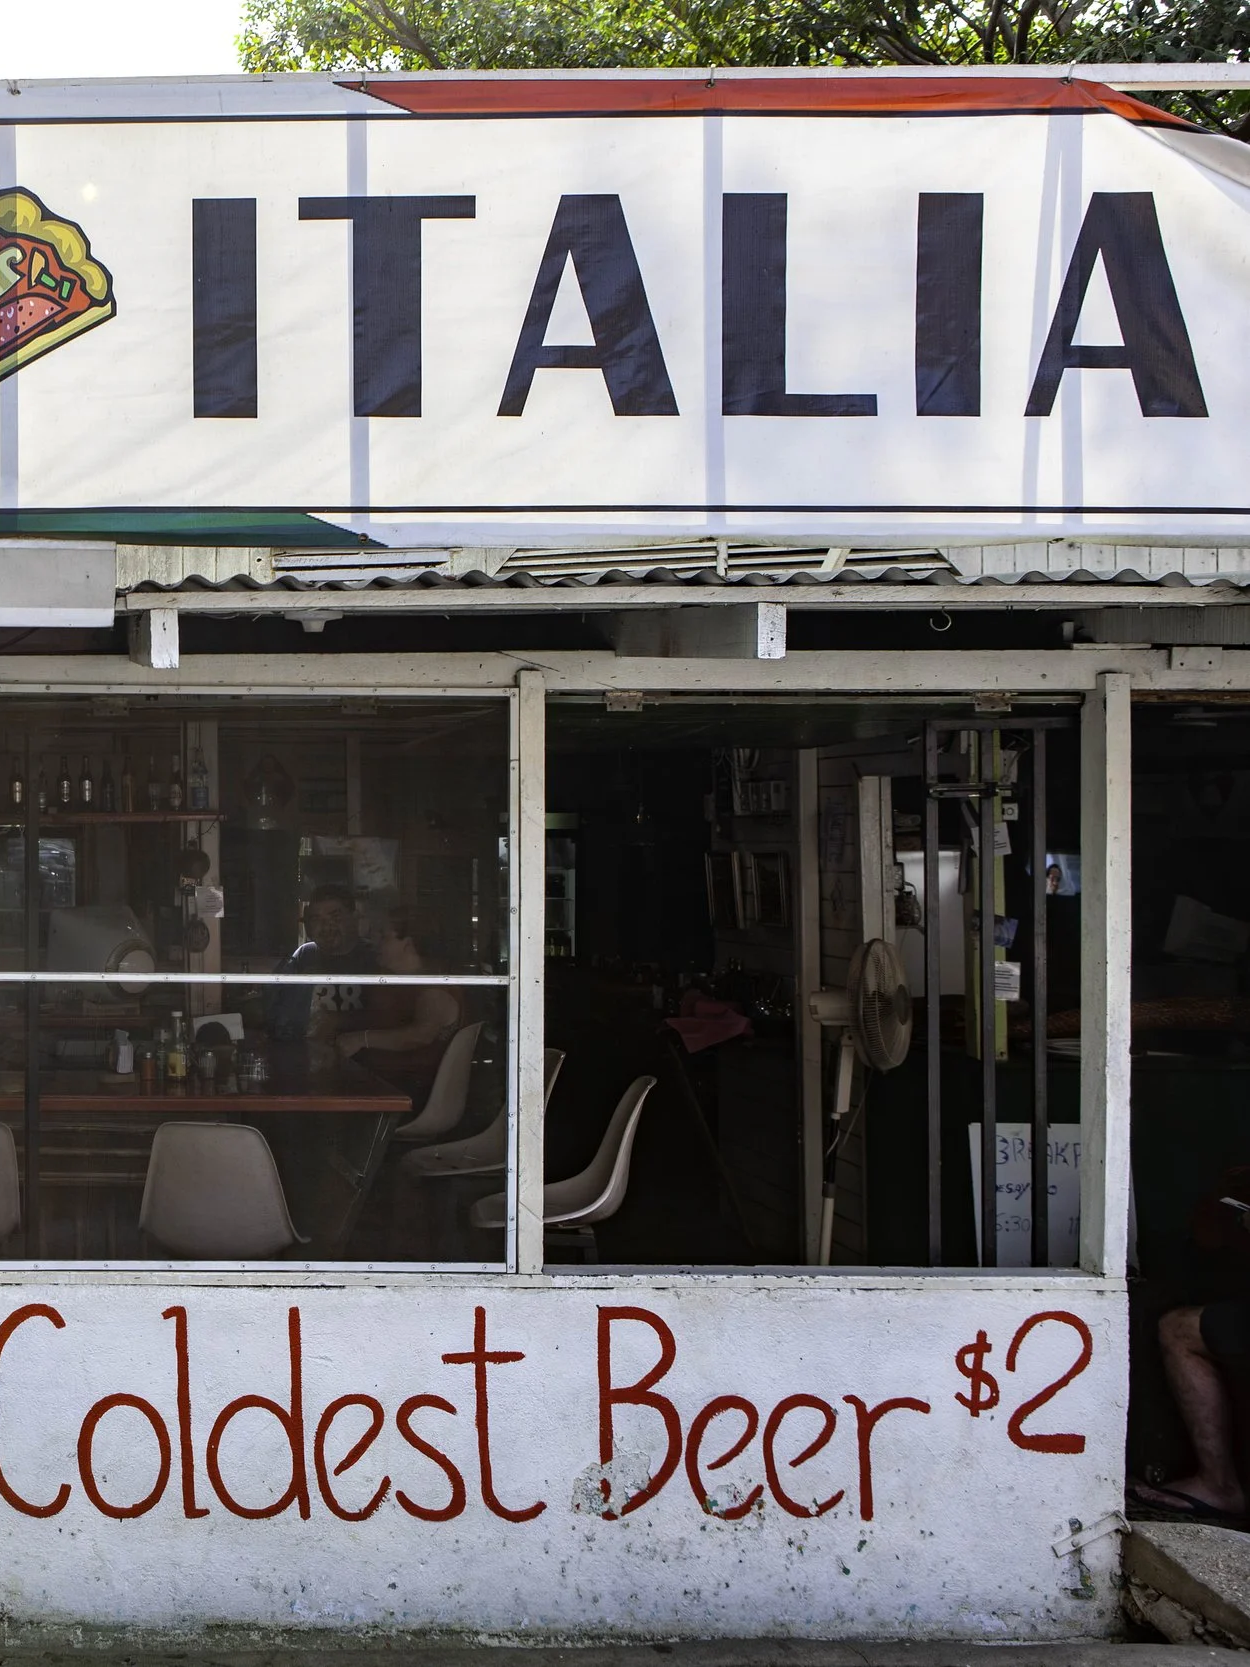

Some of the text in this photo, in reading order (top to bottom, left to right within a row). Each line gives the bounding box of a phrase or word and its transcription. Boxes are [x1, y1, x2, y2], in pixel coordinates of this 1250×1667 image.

[192, 192, 1210, 418] ITALIA
[596, 1304, 931, 1523] Beer
[955, 1310, 1094, 1455] $2
